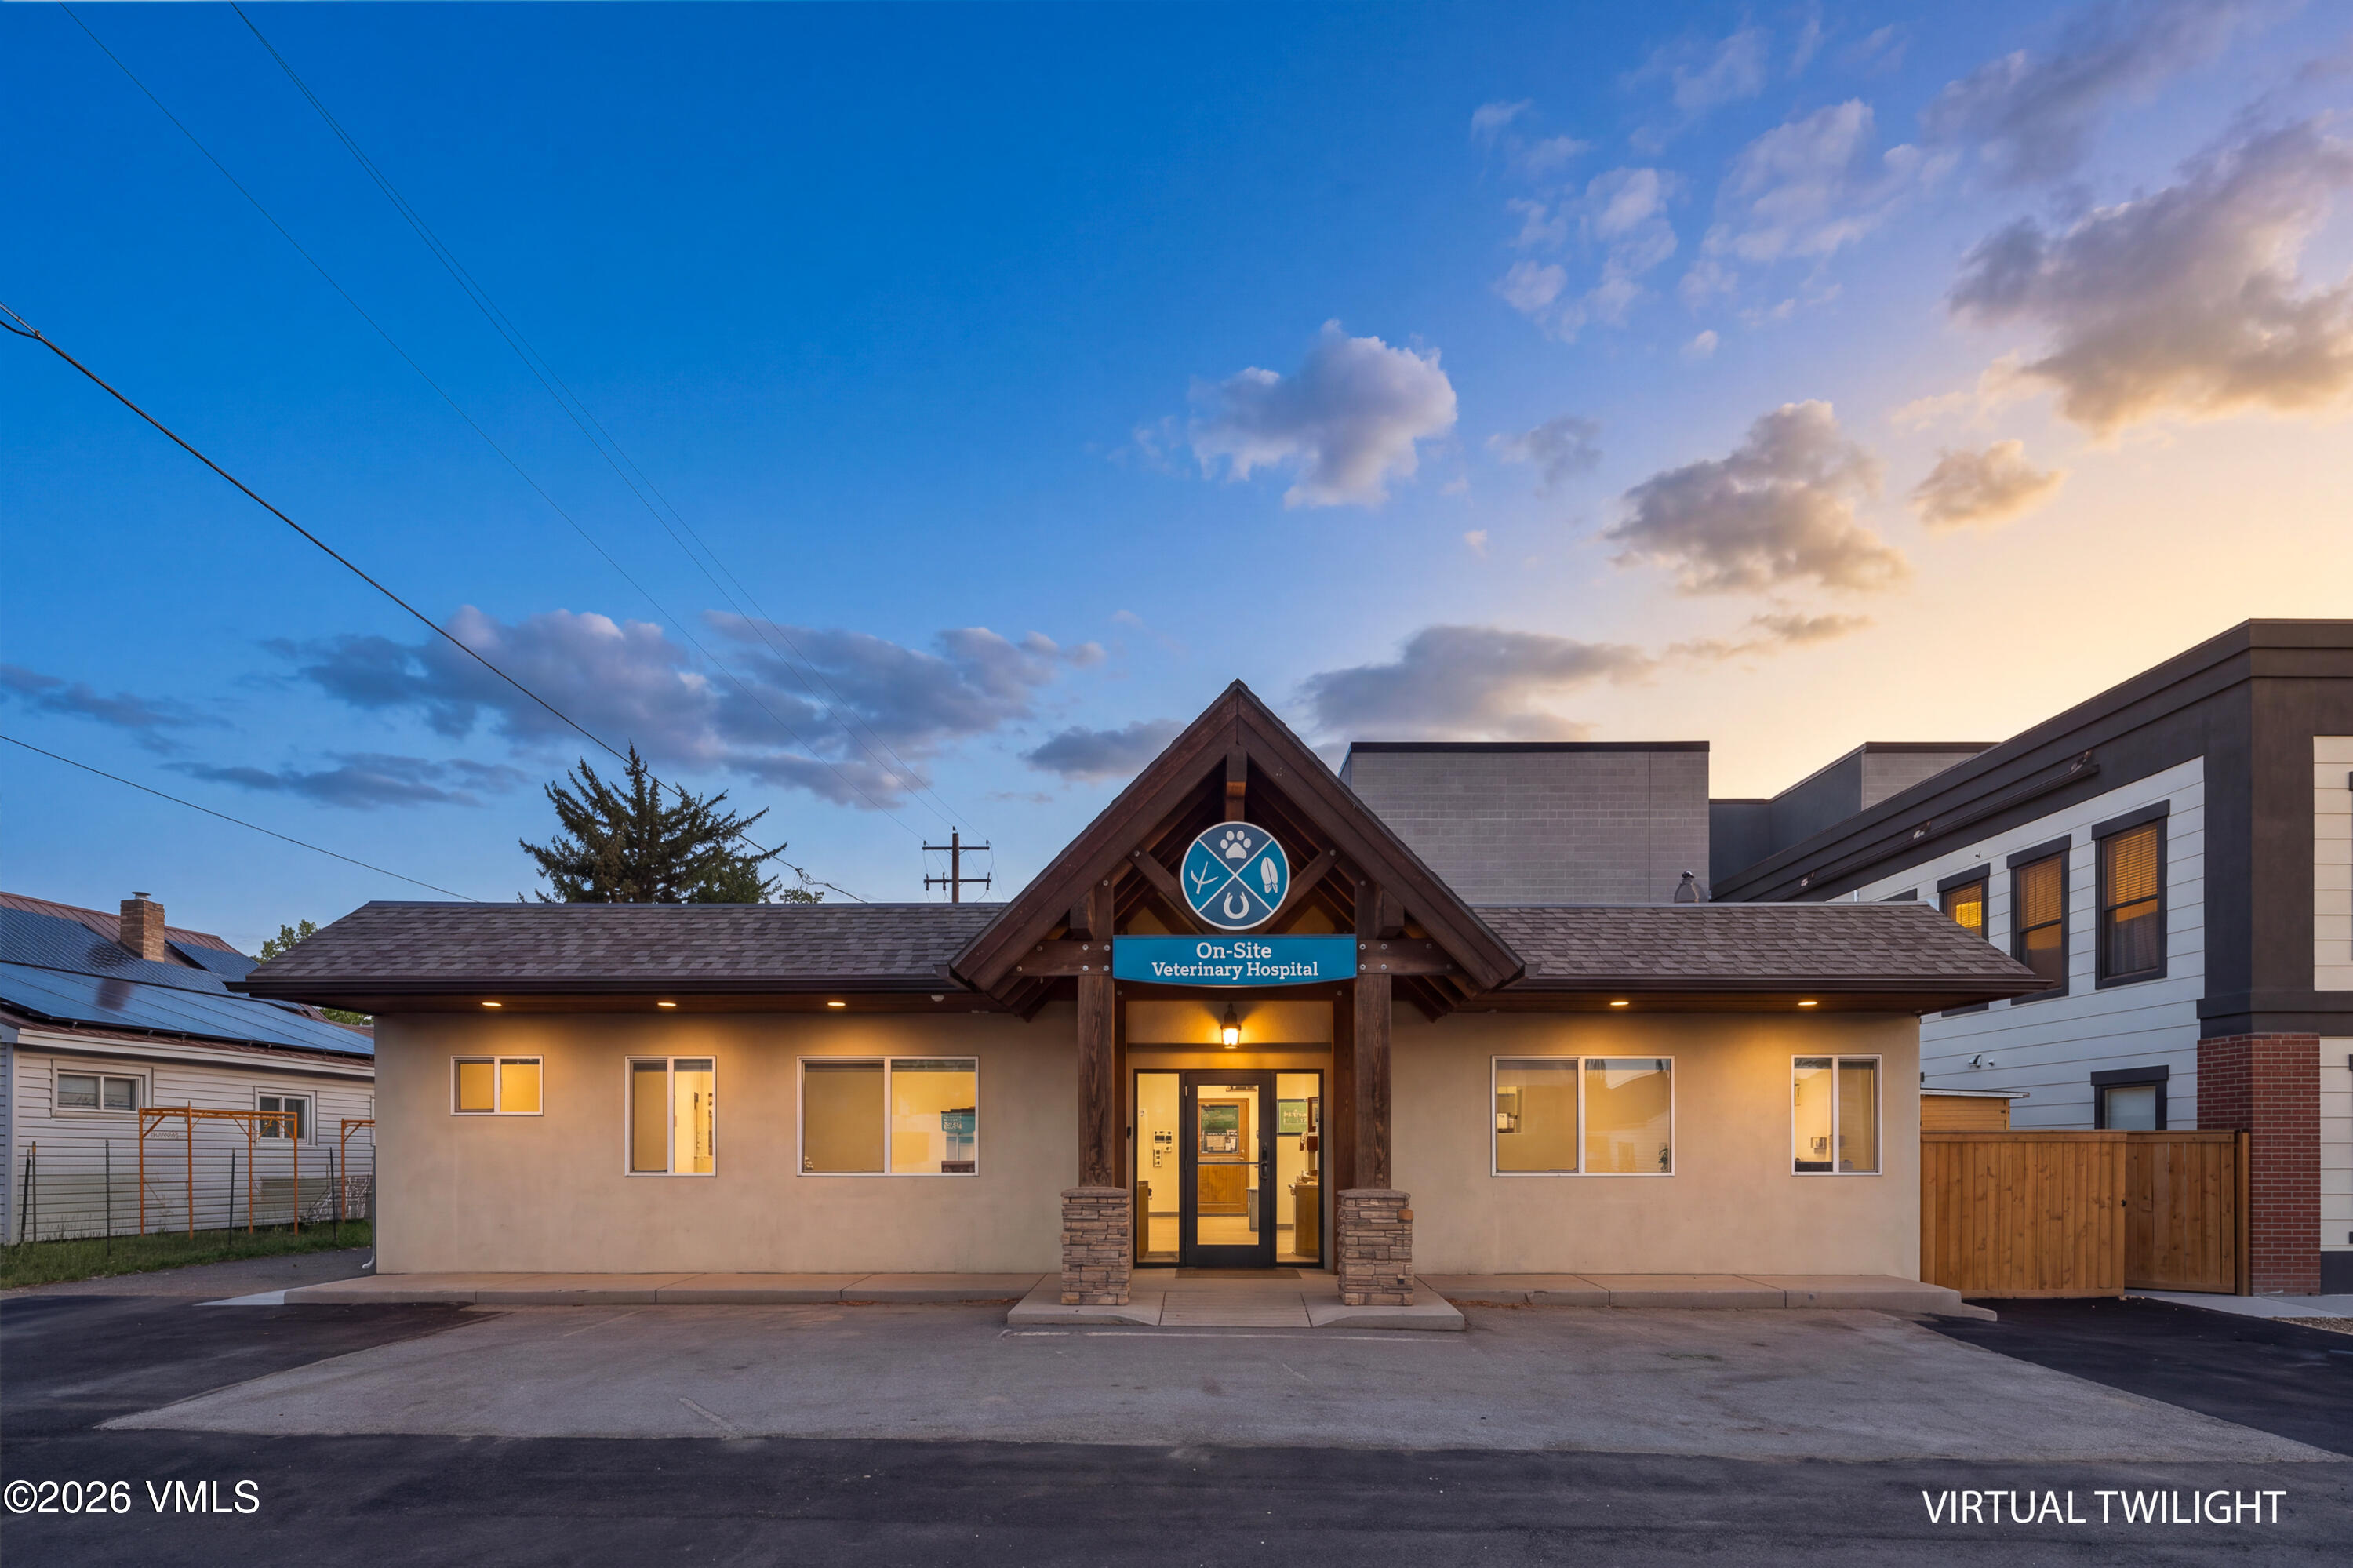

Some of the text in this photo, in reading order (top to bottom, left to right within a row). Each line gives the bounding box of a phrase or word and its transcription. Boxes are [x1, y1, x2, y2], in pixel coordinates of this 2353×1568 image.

[1196, 942, 1272, 959] On-Site
[1151, 961, 1318, 980] Veterinary Hospital
